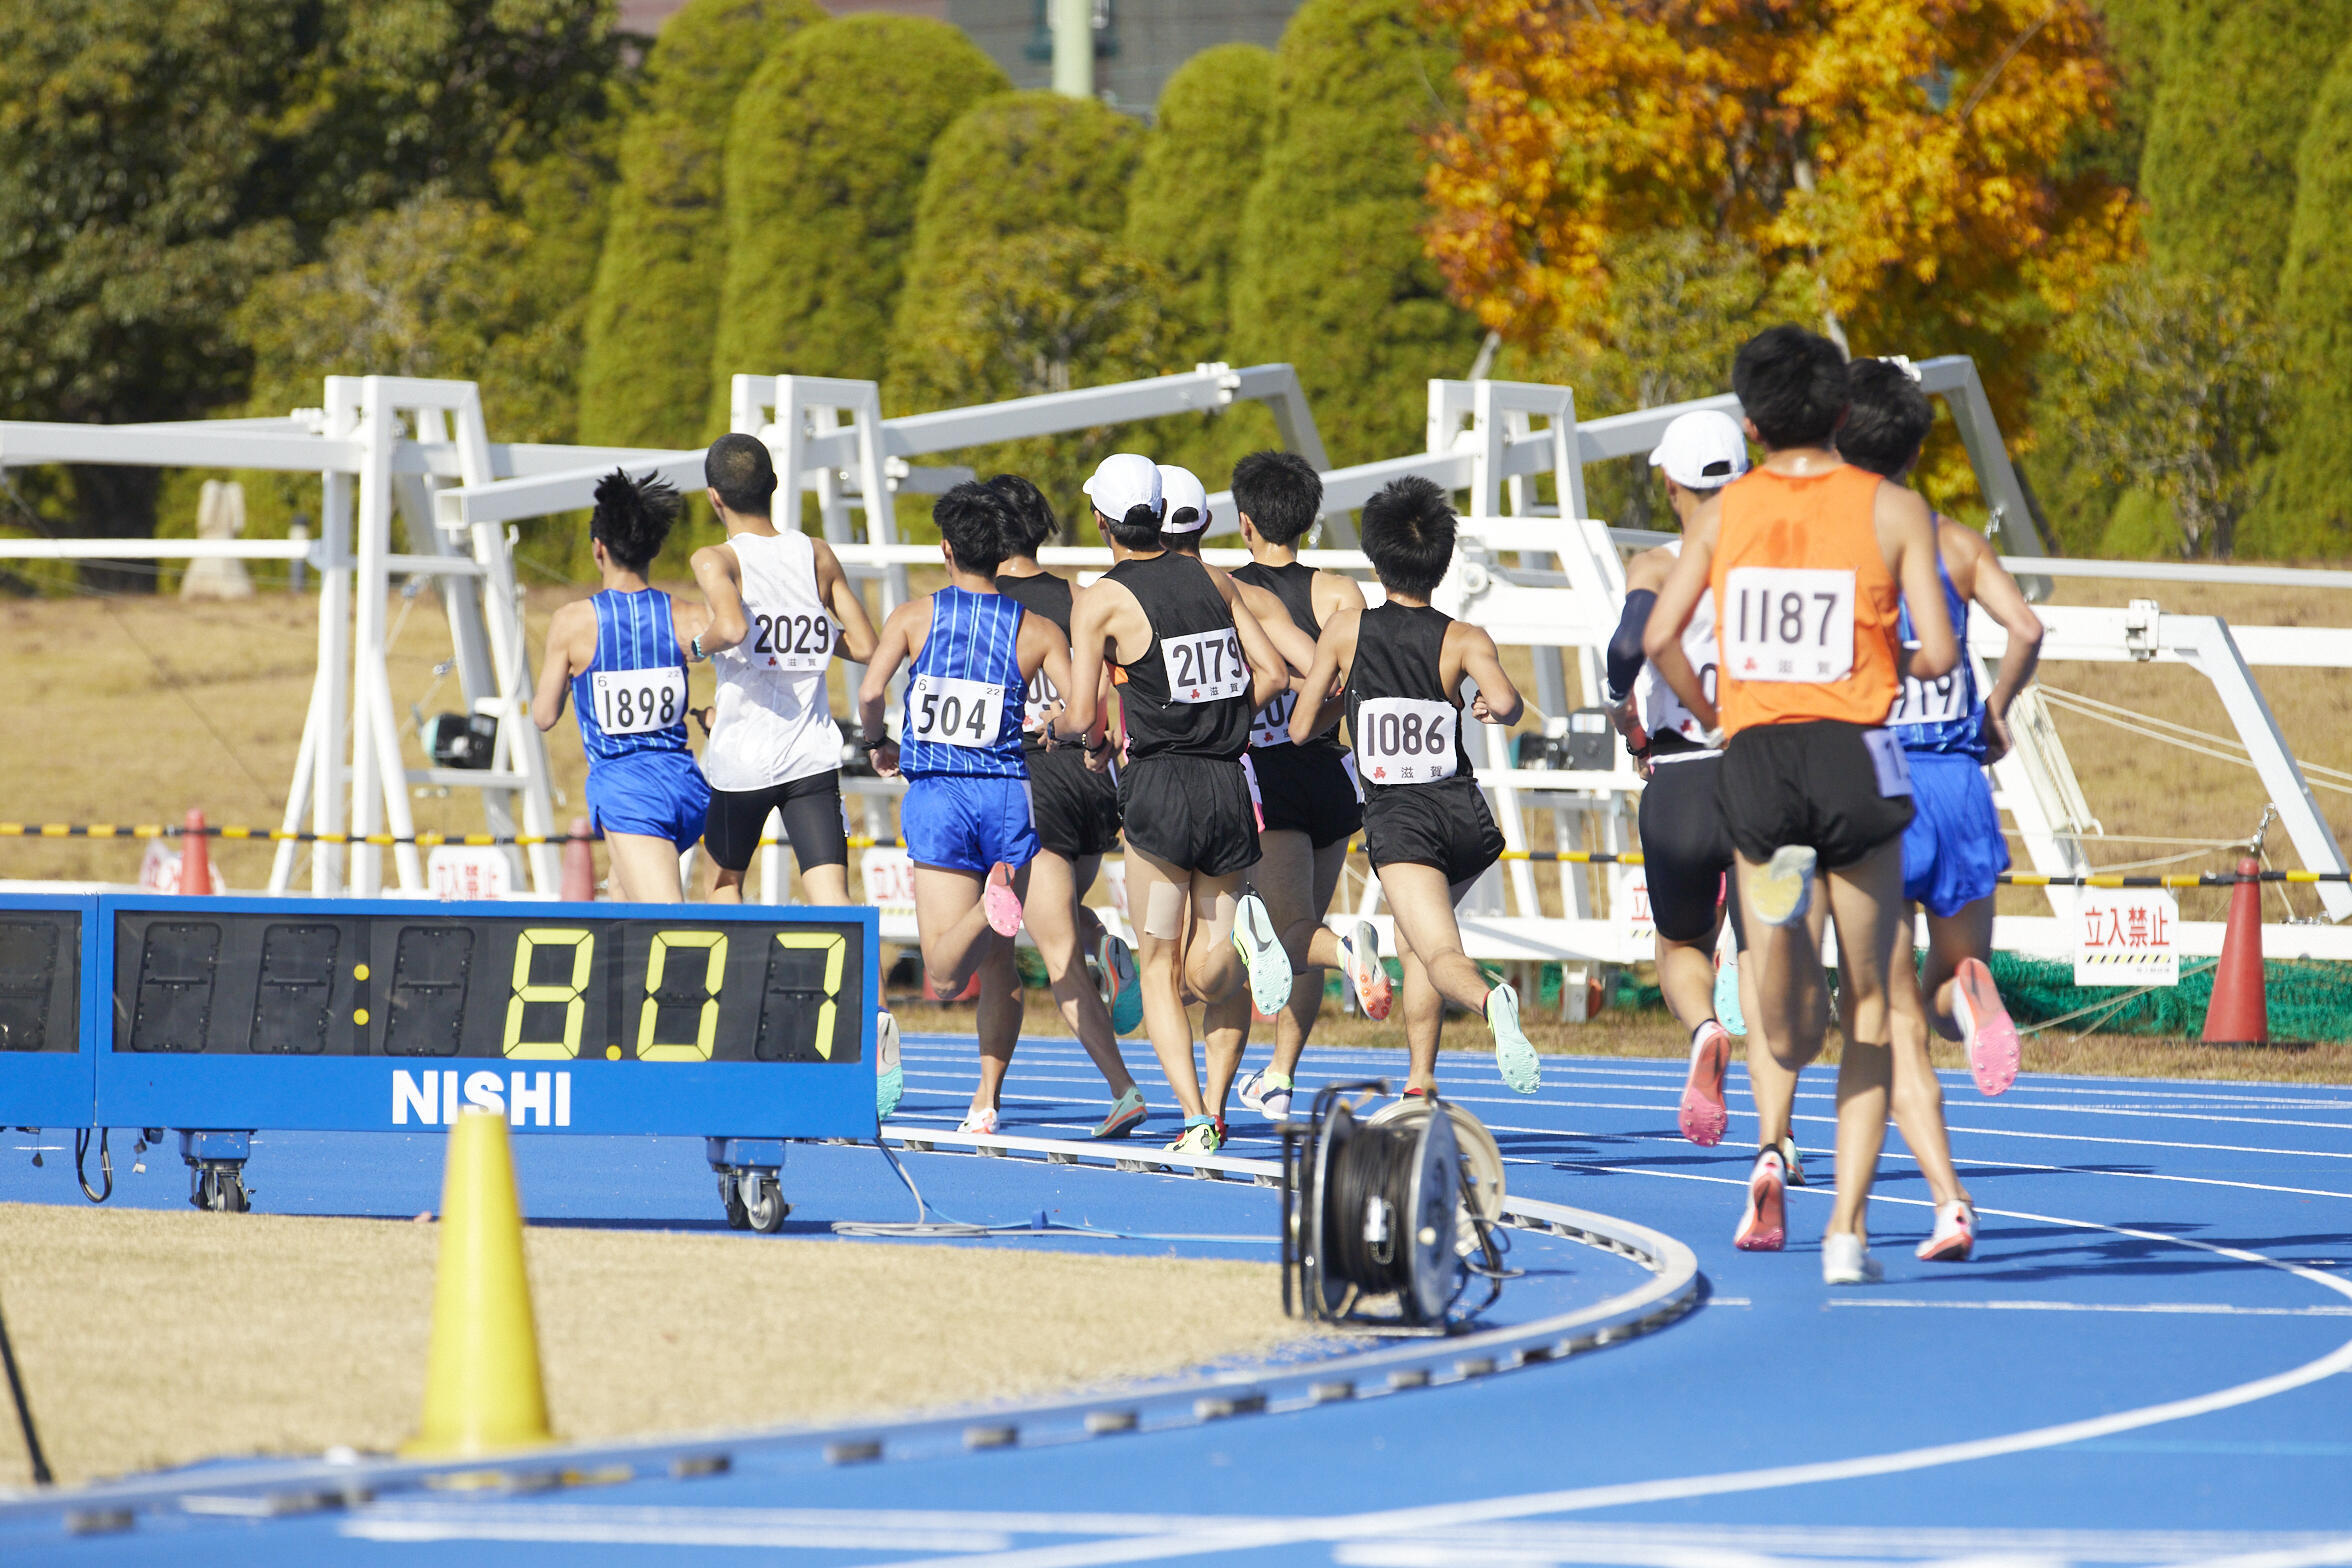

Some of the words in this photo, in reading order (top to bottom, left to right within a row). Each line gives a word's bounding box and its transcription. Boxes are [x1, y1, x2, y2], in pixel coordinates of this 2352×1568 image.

[754, 614, 829, 654] 2029
[1739, 588, 1837, 647] 1187
[597, 675, 608, 688] 6
[1172, 637, 1243, 688] 2179
[604, 686, 674, 728] 1898
[918, 678, 928, 691] 6
[986, 686, 1001, 697] 22
[917, 693, 987, 740] 504
[1367, 712, 1446, 757] 1086
[2084, 905, 2171, 949] 立入禁止
[392, 1070, 571, 1127] NISHI
